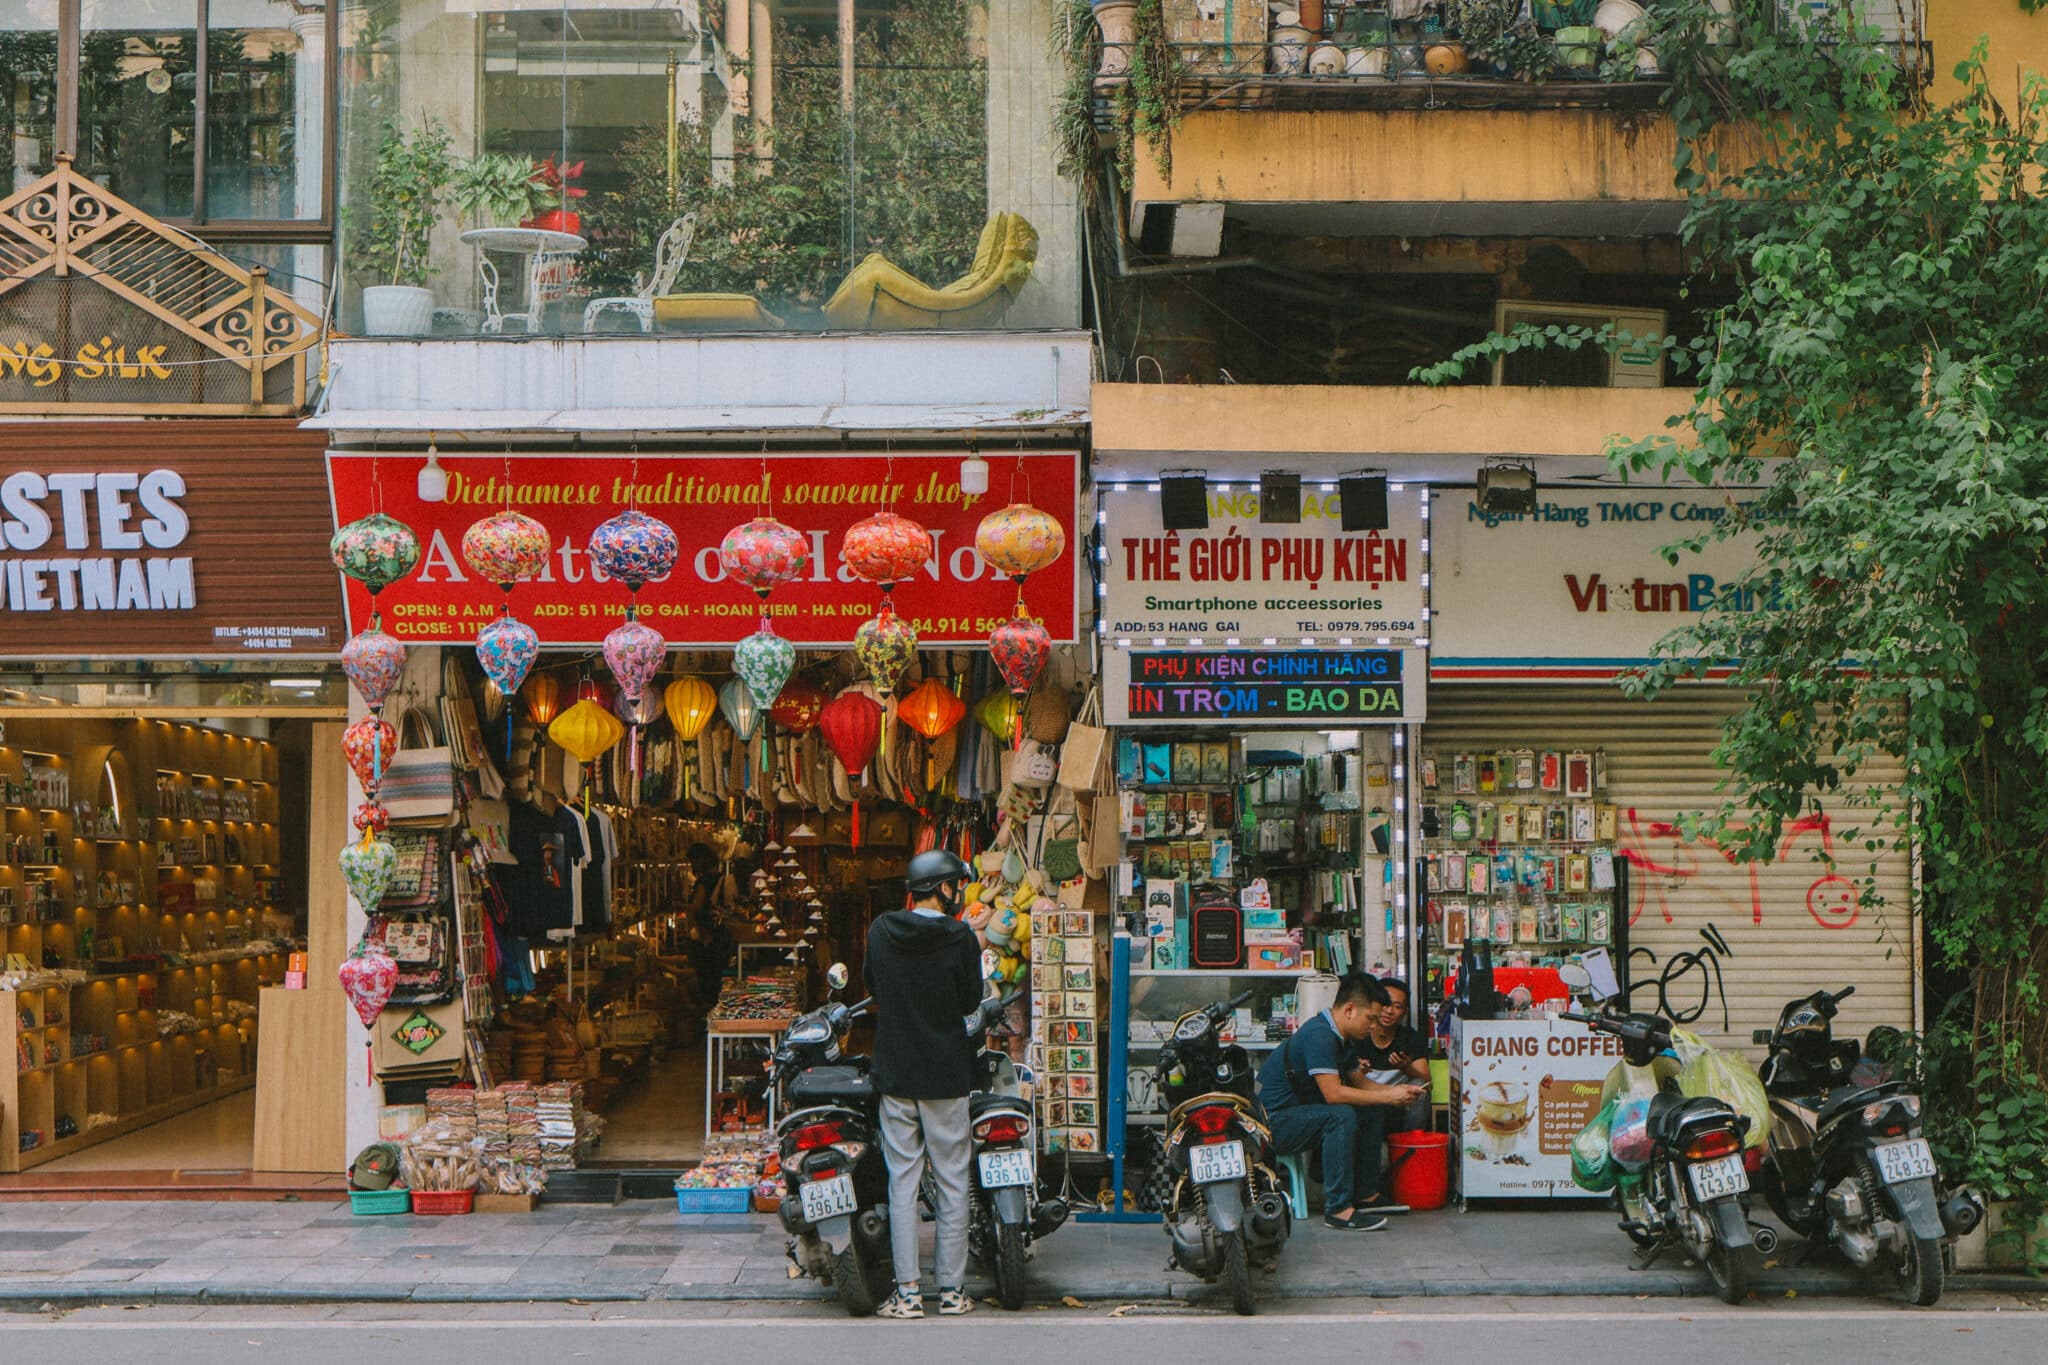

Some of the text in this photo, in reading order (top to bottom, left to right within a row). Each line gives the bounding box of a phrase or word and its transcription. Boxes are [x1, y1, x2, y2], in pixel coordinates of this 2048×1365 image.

[444, 472, 602, 504] Vietnamese
[612, 472, 772, 504] traditional
[783, 475, 904, 504] souvenir
[0, 469, 190, 550] STES
[1533, 502, 1590, 527] Hàng
[1597, 502, 1664, 521] TMCP
[417, 529, 469, 582] A
[1189, 526, 1251, 582] GIỚI
[1262, 538, 1324, 590] PHỤ
[1333, 530, 1407, 590] KIỆN
[393, 604, 494, 616] OPEN: 8 A.M
[534, 604, 574, 616] ADD:
[580, 604, 597, 616] 51
[659, 604, 689, 616] GAI
[704, 604, 753, 616] HOAN
[759, 604, 797, 616] KIEM
[813, 604, 837, 616] HA
[842, 604, 872, 616] NOI
[1145, 596, 1383, 613] Smartphone acceessories
[396, 622, 487, 634] CLOSE: 11P
[1114, 621, 1240, 632] ADD: 53 HANG GAI
[1297, 620, 1415, 632] TEL: 0979.795.694
[1144, 658, 1188, 680] PHỤ
[1195, 655, 1246, 680] KIỆN
[1252, 654, 1318, 675] CHÍNH
[1287, 688, 1349, 712] BAO
[1360, 688, 1400, 712] DA
[1471, 1036, 1539, 1057] GIANG
[1199, 1144, 1235, 1163] 29-C1
[985, 1167, 1030, 1185] 936.10
[1197, 1160, 1242, 1180] 003.33
[1885, 1158, 1931, 1180] 248.32
[1699, 1172, 1742, 1197] 143.97
[807, 1194, 853, 1218] 396.44
